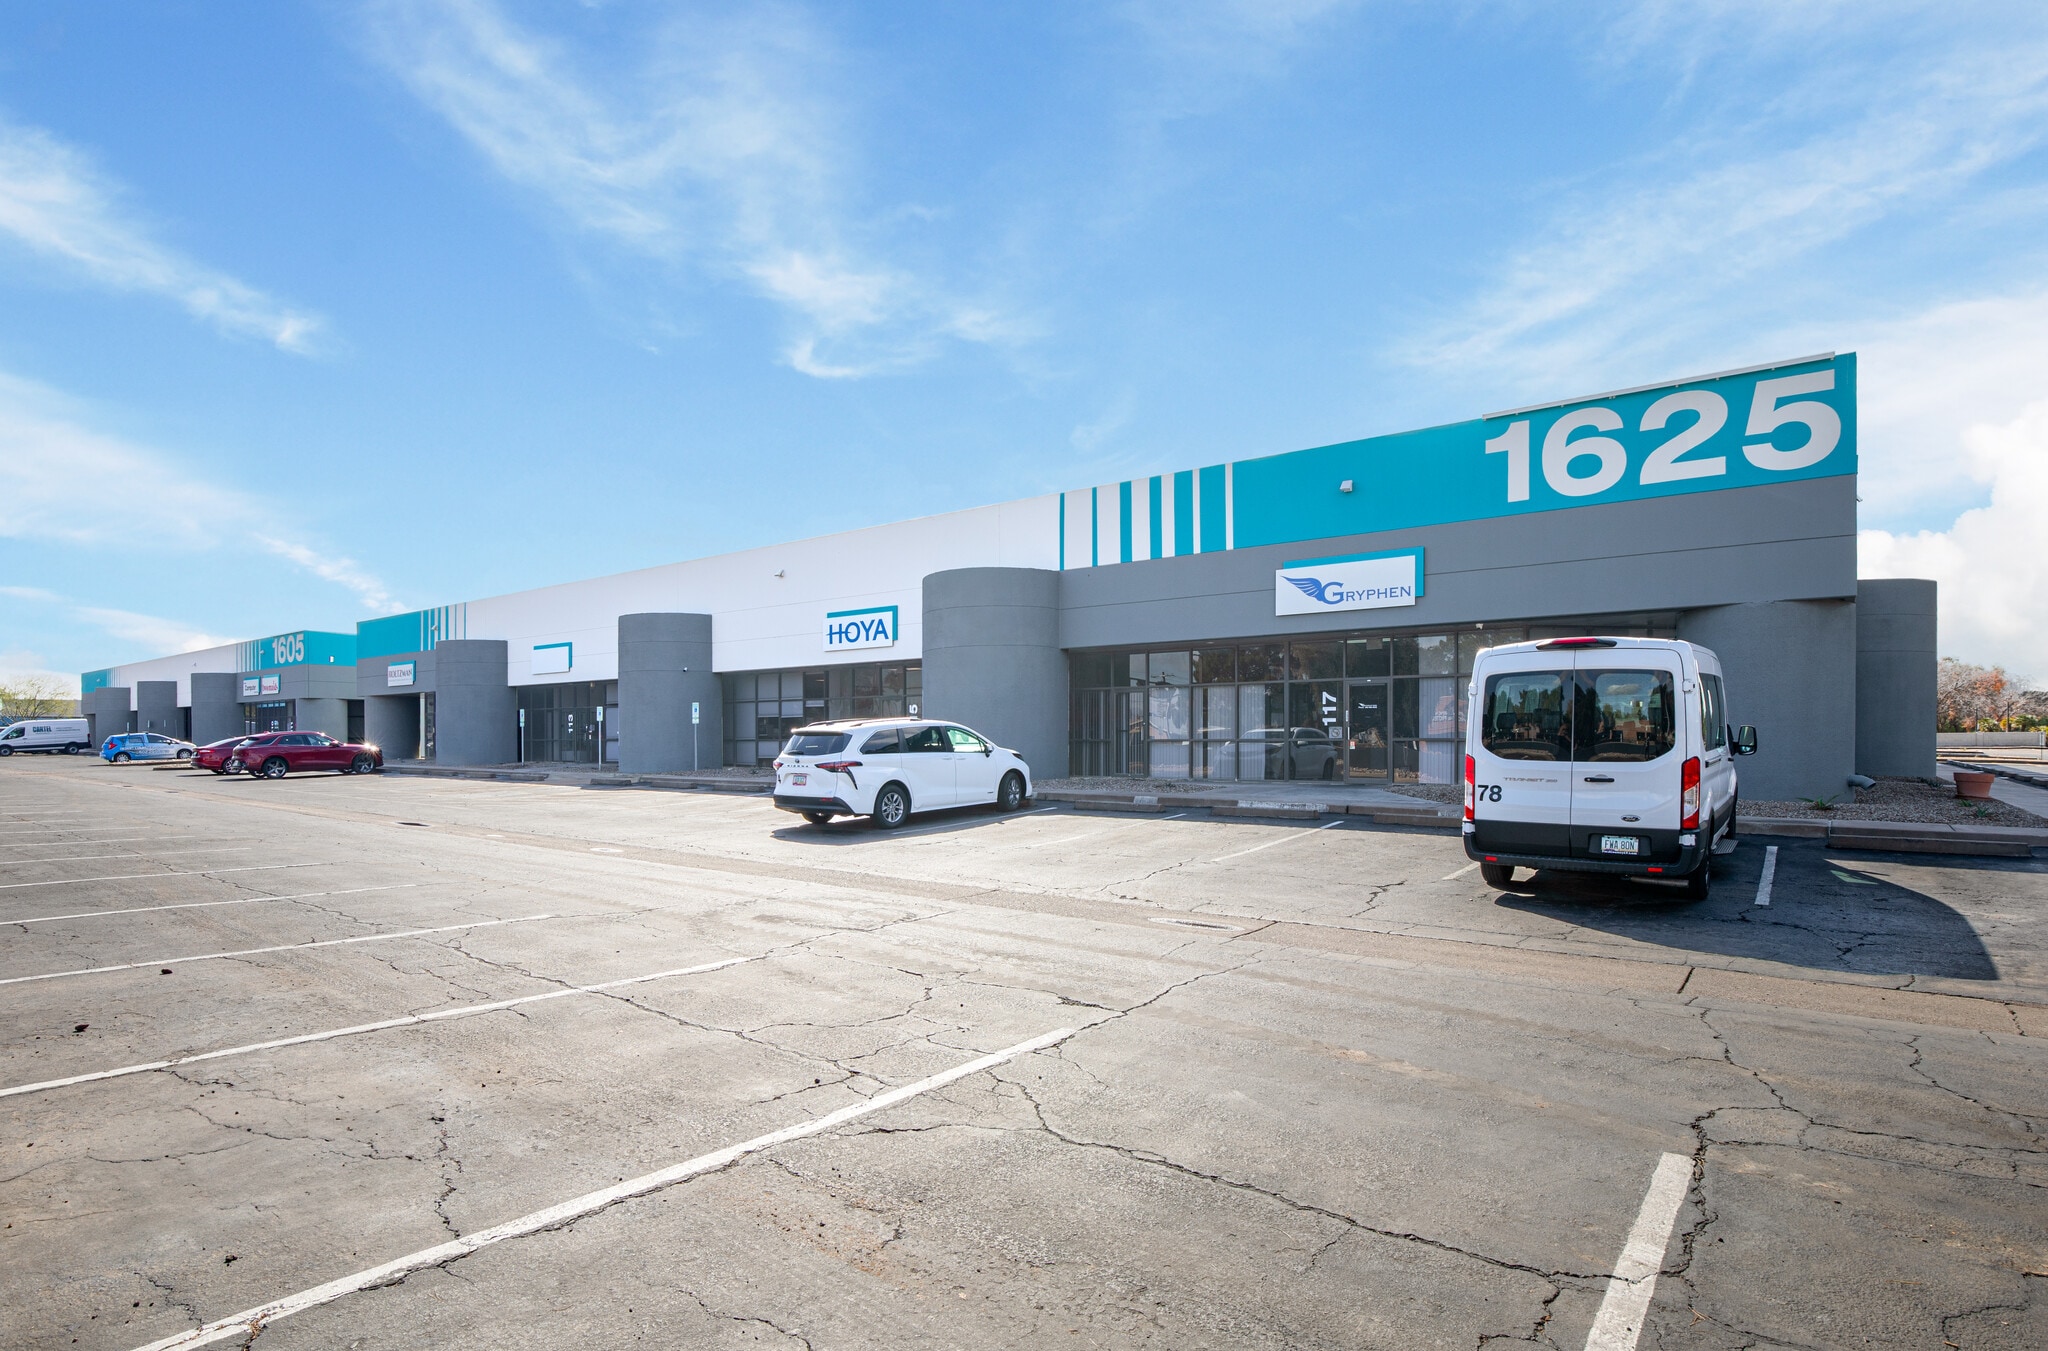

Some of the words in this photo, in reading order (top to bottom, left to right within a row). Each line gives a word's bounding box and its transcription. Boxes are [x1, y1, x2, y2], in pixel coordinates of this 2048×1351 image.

[1485, 369, 1842, 503] 1625
[1321, 581, 1411, 605] GRYPHEN
[826, 618, 889, 645] HOYA
[272, 633, 304, 664] 1605
[1322, 691, 1336, 726] 117
[1477, 784, 1503, 803] 78
